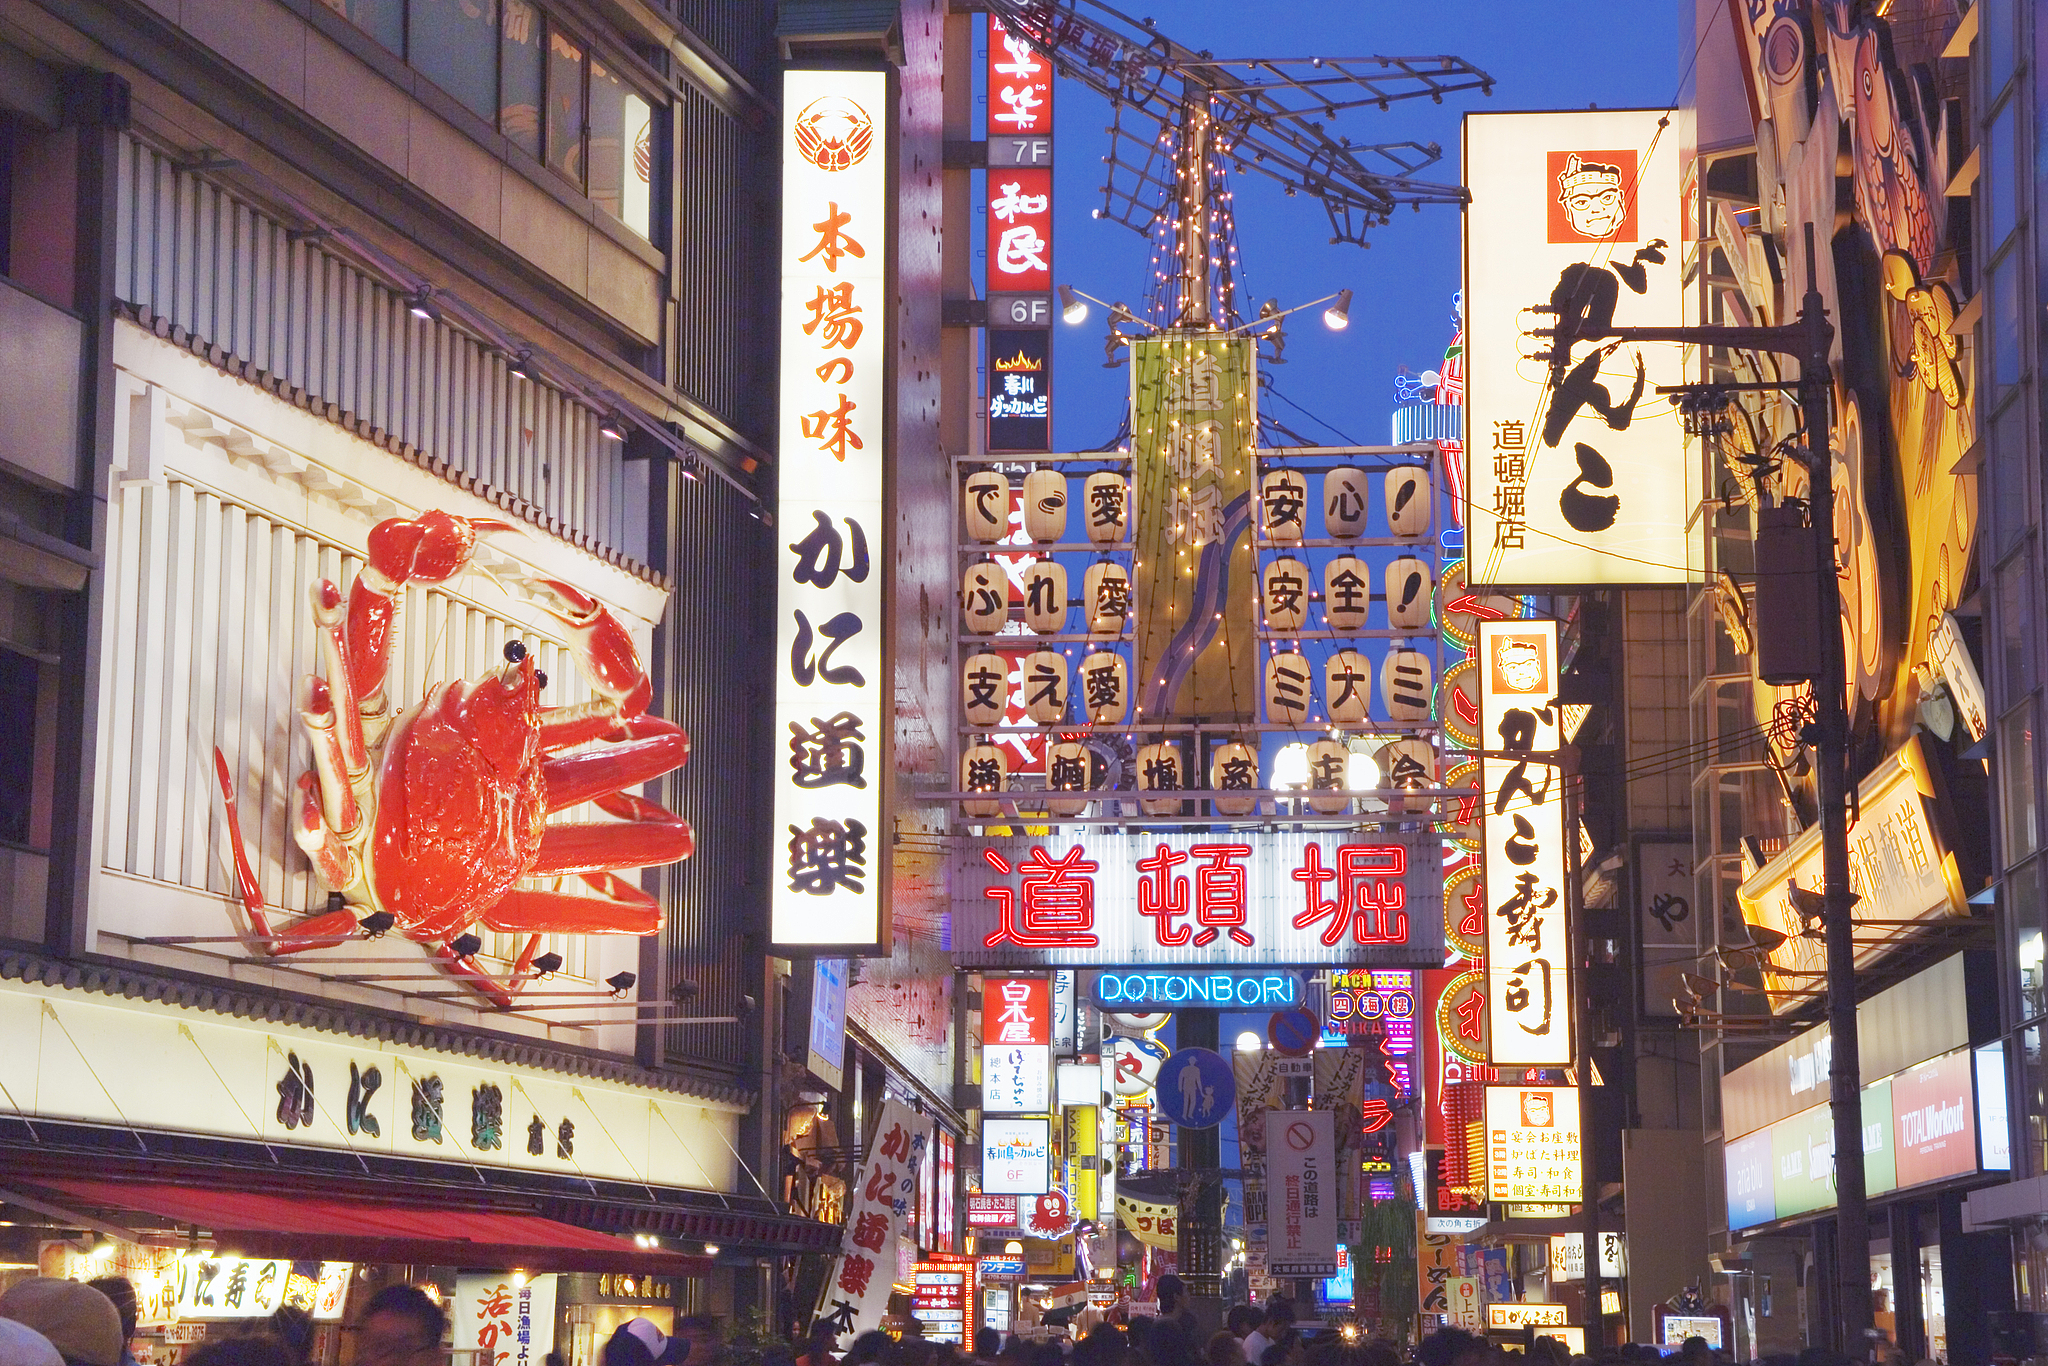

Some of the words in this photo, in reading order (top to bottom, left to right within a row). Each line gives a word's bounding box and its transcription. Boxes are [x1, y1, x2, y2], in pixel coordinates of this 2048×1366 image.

[1012, 142, 1048, 161] 7F
[991, 181, 1048, 272] 和民
[798, 201, 866, 462] 本場の味
[1010, 300, 1048, 322] 6F
[990, 394, 1048, 418] ダッカルビ
[1004, 373, 1034, 395] 春川
[1542, 238, 1669, 533] がんこ
[1163, 353, 1227, 546] 道頓堀
[1493, 419, 1525, 551] 道頓堀店
[966, 574, 1127, 619] ふれ愛
[967, 663, 1120, 709] 支え愛
[1273, 664, 1428, 711] ミナミ
[1493, 695, 1558, 1036] がんこ寿司
[986, 843, 1411, 950] 道頓堀
[1099, 974, 1294, 1004] DOTONBORI
[1332, 974, 1412, 988] PACHINKO
[997, 980, 1036, 1042] 白木屋
[1279, 1062, 1313, 1073] 自動車
[1511, 1130, 1579, 1144] 宴会お座敷
[892, 1131, 926, 1218] 本場の味
[1007, 1170, 1024, 1180] 6F
[1069, 1109, 1077, 1217] MARUTOMI
[1303, 1157, 1319, 1219] この道路は
[1285, 1174, 1302, 1250] 終日通行禁止
[1437, 1219, 1462, 1228] 次の角
[1273, 1265, 1336, 1274] 大阪府南警察署
[1508, 1309, 1565, 1324] がんこ寿司
